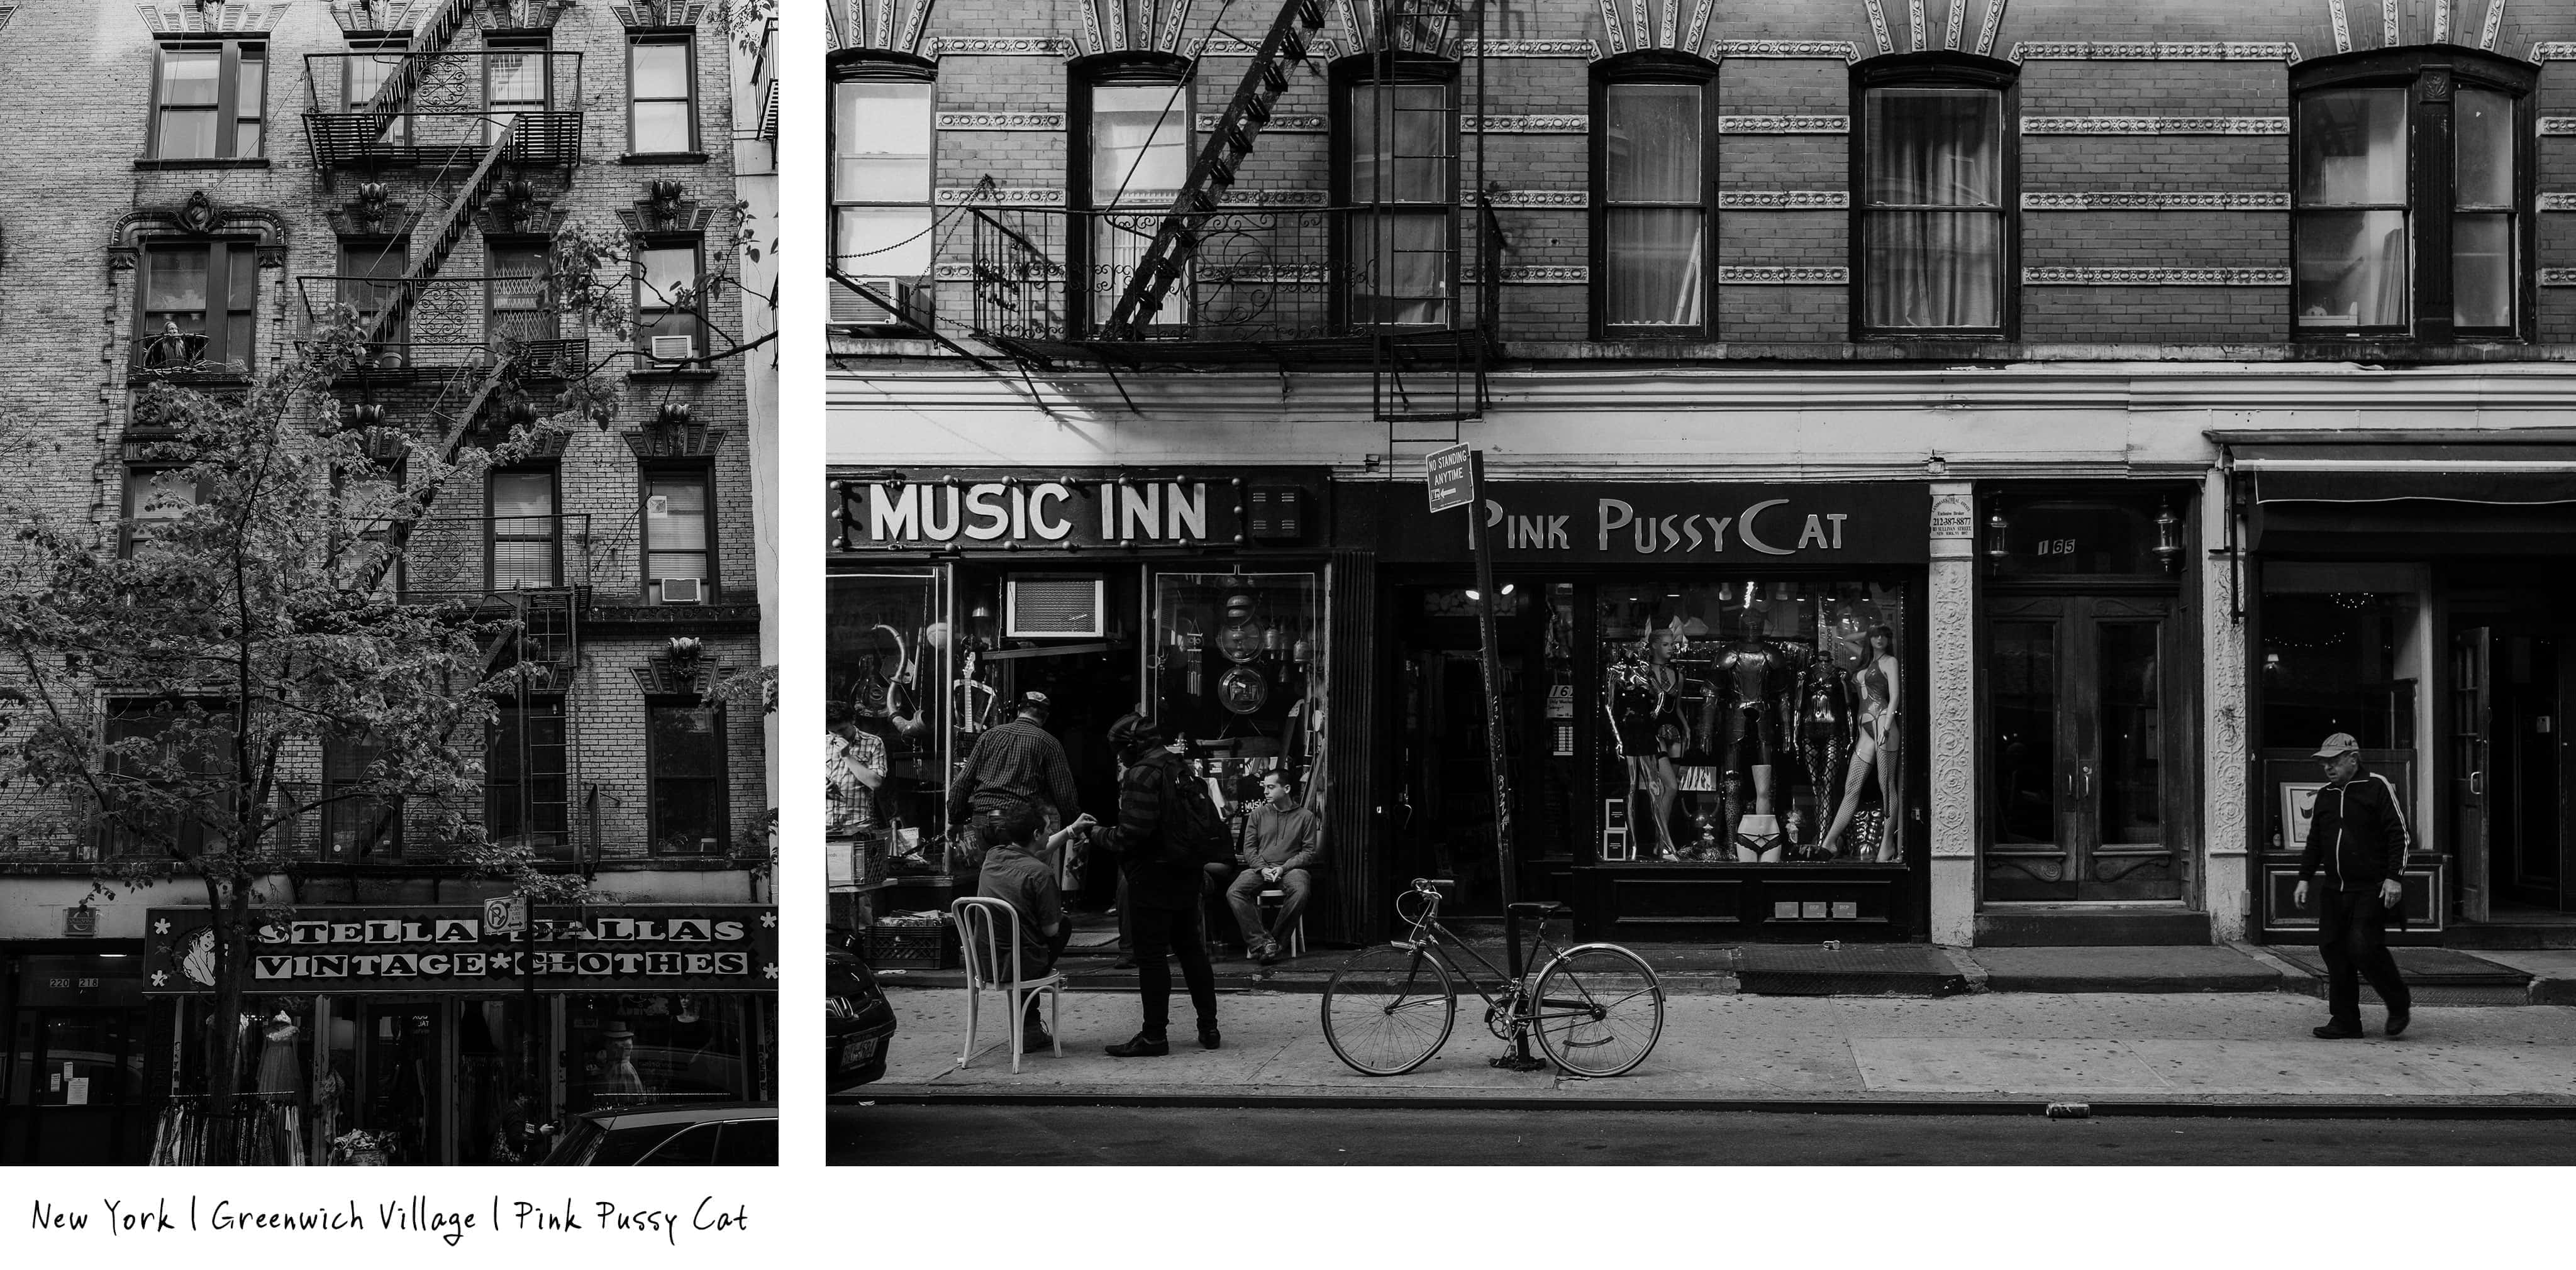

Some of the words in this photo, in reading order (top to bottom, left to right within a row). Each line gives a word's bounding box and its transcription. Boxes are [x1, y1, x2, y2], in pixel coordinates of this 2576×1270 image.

[1428, 459, 1437, 473] NO
[1438, 450, 1467, 470] STANDING
[1435, 467, 1464, 487] ANYTIME
[870, 483, 1073, 541] MUSIC
[1101, 483, 1206, 541] INN
[1933, 517, 1971, 526] 212-387-8877
[1469, 499, 1570, 551] PINK
[2038, 539, 2075, 554] 165
[258, 920, 478, 944] STELLA
[257, 953, 486, 978] VINTAGE
[515, 951, 748, 975] CLOTHES
[50, 979, 69, 987] 220
